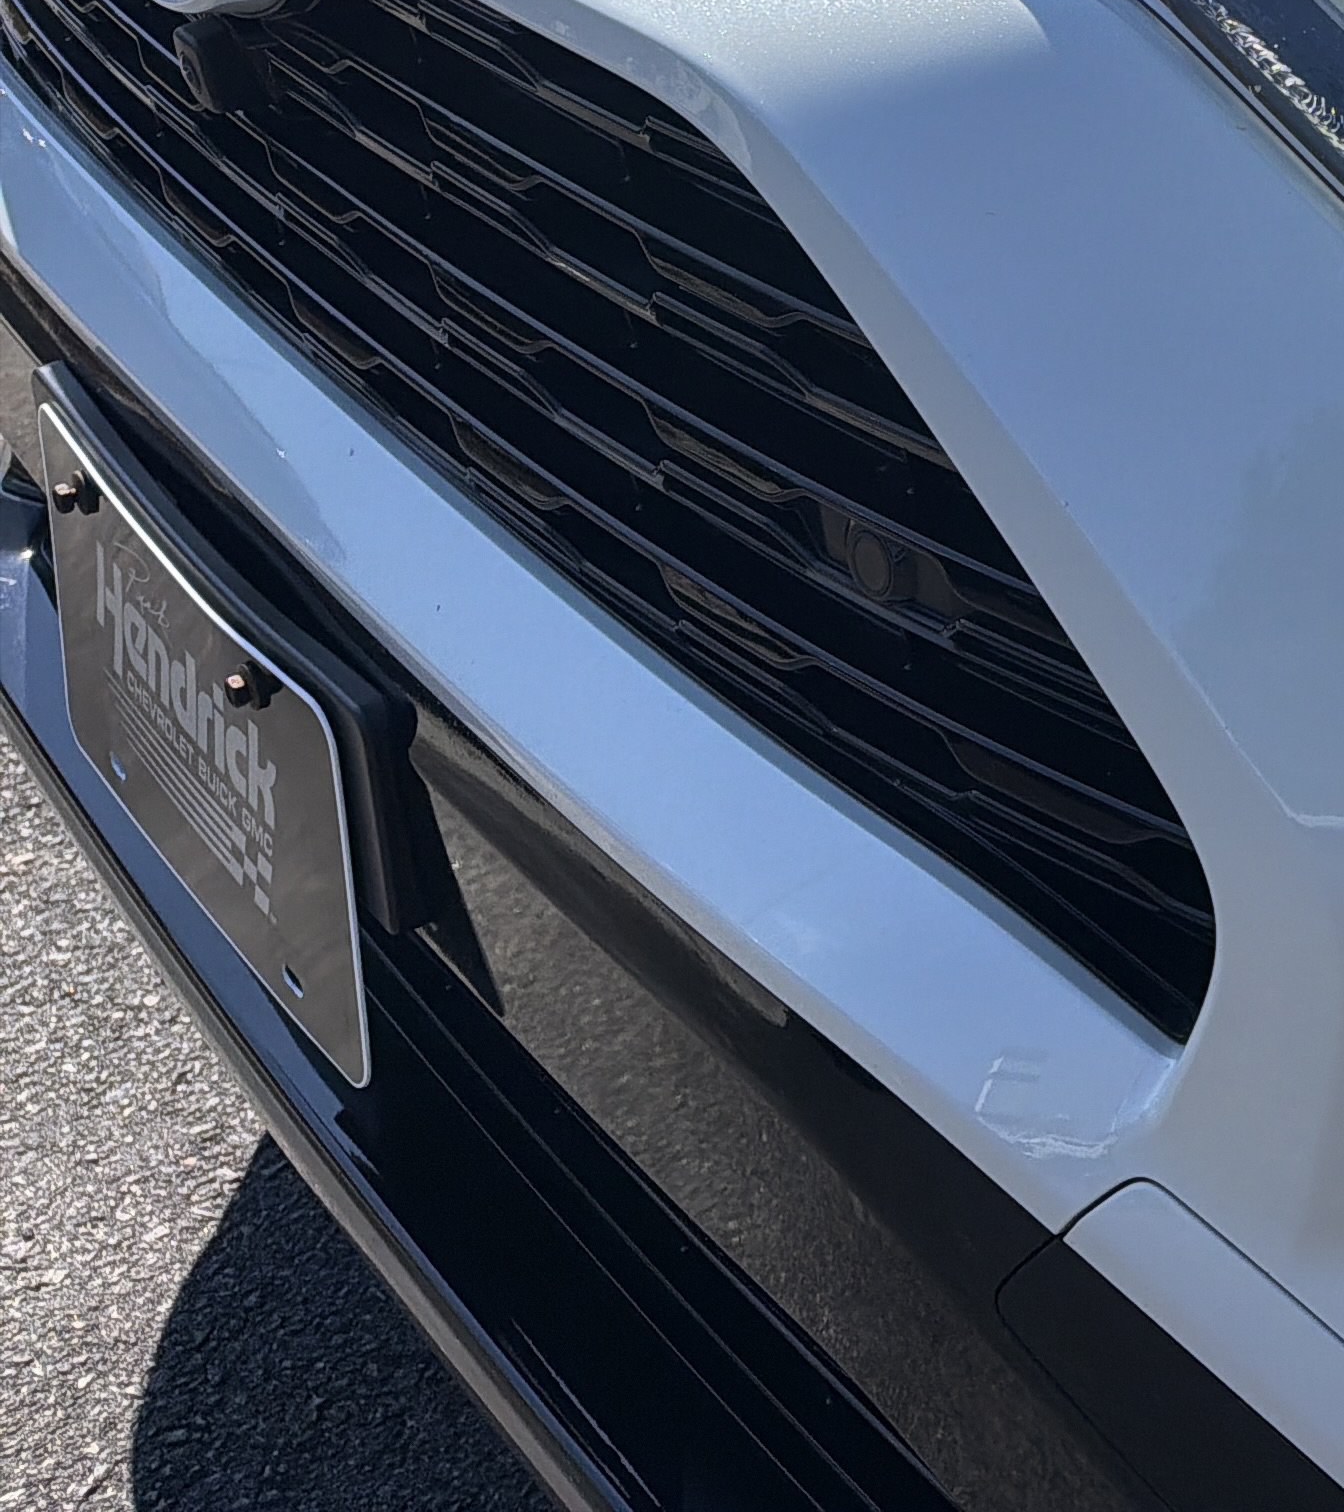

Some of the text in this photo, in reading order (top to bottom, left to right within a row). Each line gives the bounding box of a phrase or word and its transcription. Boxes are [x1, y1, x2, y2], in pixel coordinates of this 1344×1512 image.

[95, 540, 277, 830] Hendrick
[126, 669, 274, 857] CHEVROLET BUICK GMC
